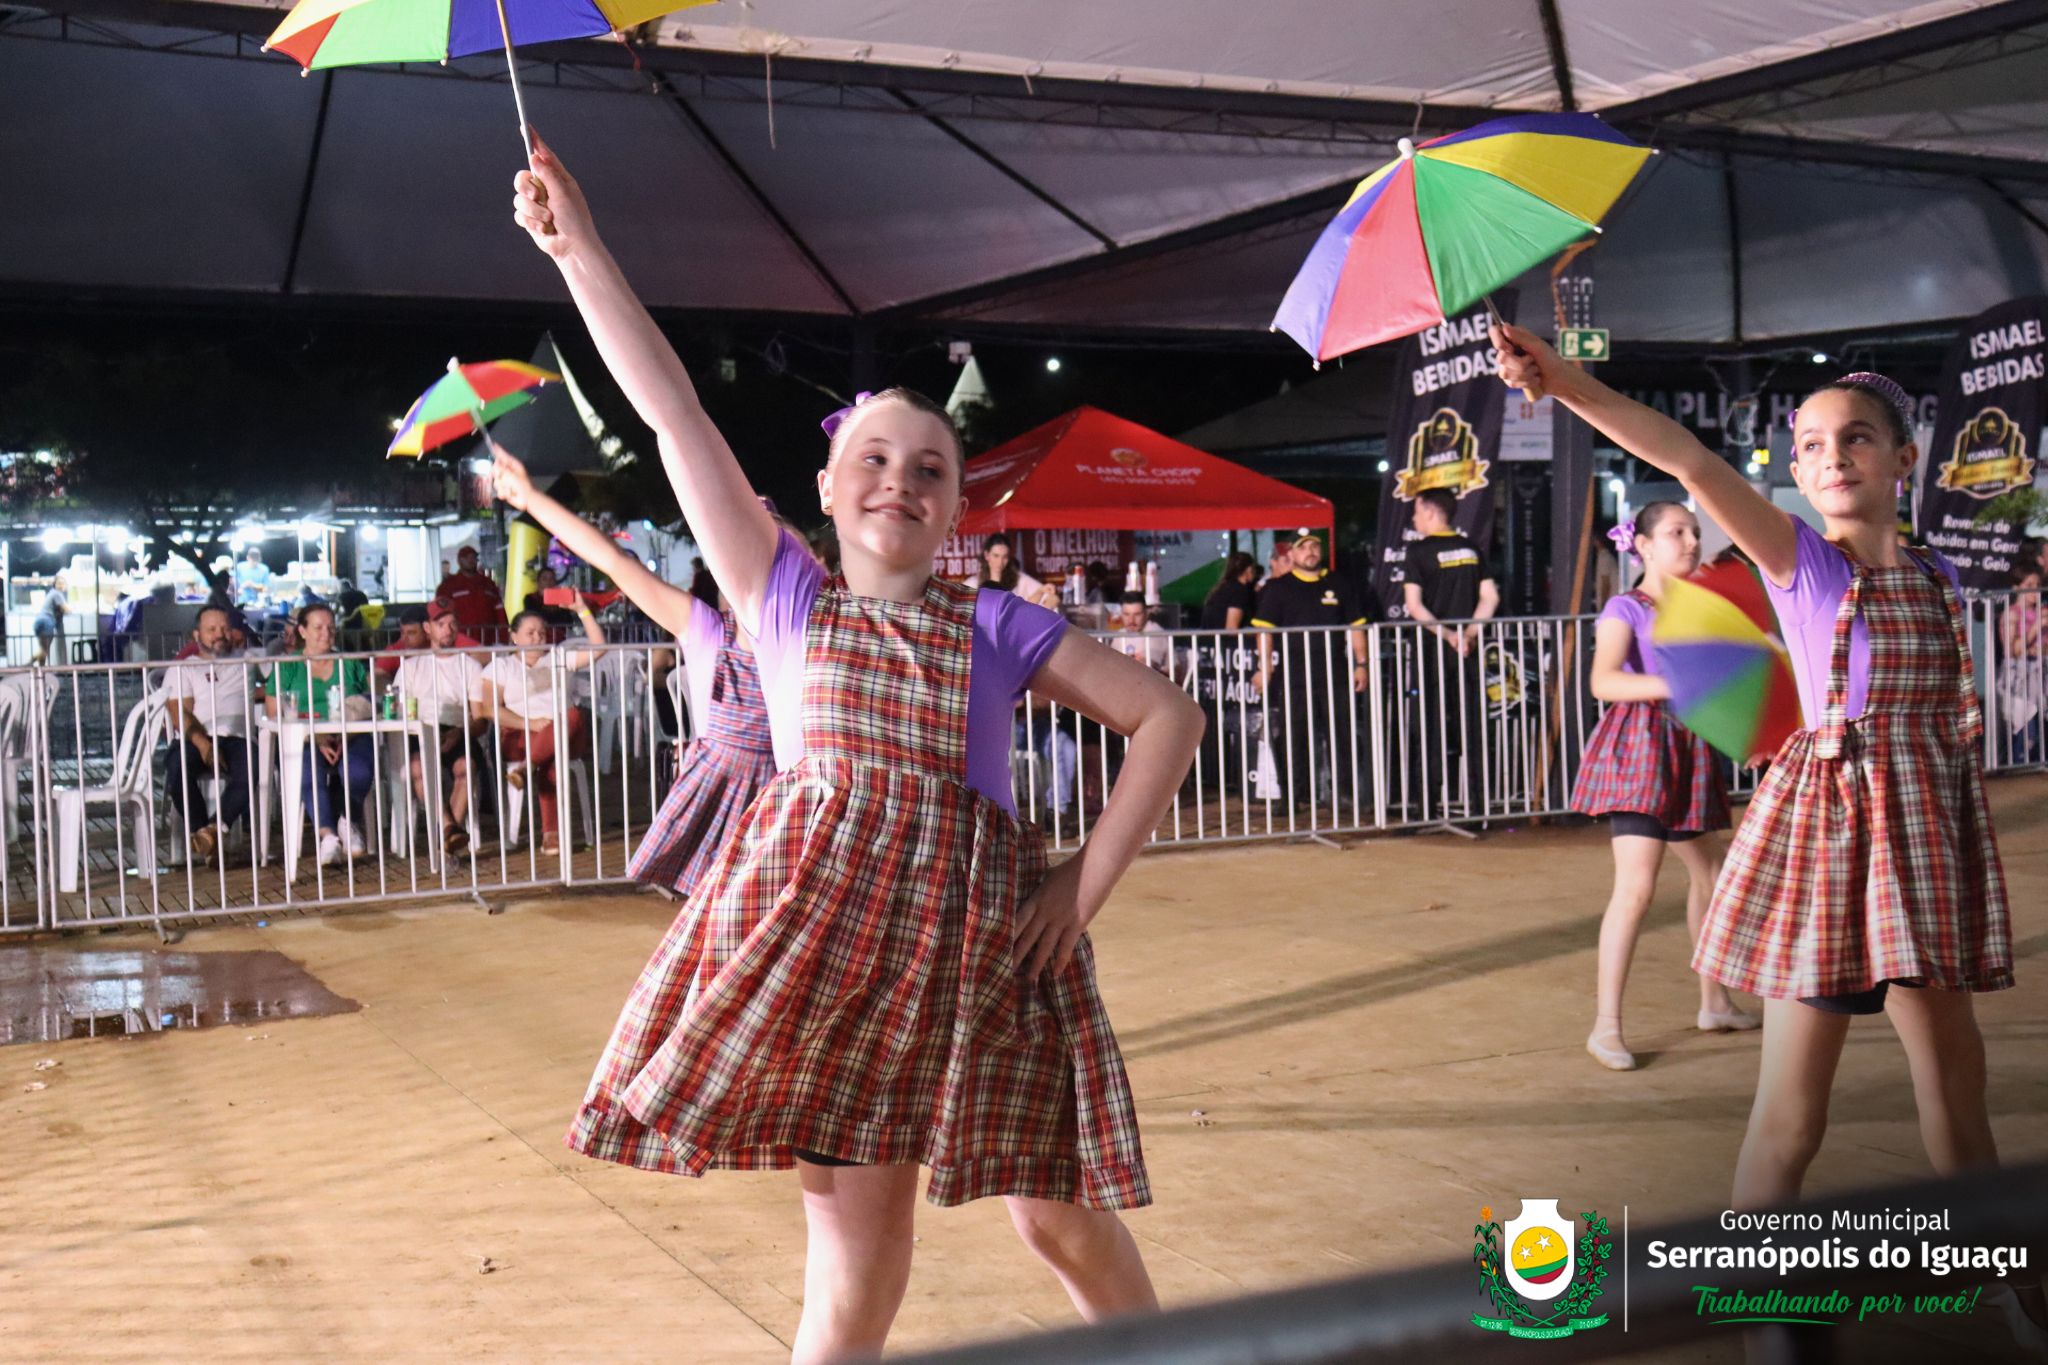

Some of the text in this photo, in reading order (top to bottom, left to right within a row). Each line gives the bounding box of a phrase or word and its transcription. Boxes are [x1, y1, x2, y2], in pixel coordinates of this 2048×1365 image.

[1970, 319, 2046, 359] ISMAEL
[1412, 347, 1500, 396] BEBIDAS
[1961, 352, 2045, 396] BEBIDAS
[1075, 464, 1203, 477] PLANETA CHOPP
[1993, 518, 2011, 535] de
[1035, 528, 1120, 556] O MELHOR
[1925, 530, 2022, 554] Bebidas em Gera
[1982, 555, 2011, 572] Gelo
